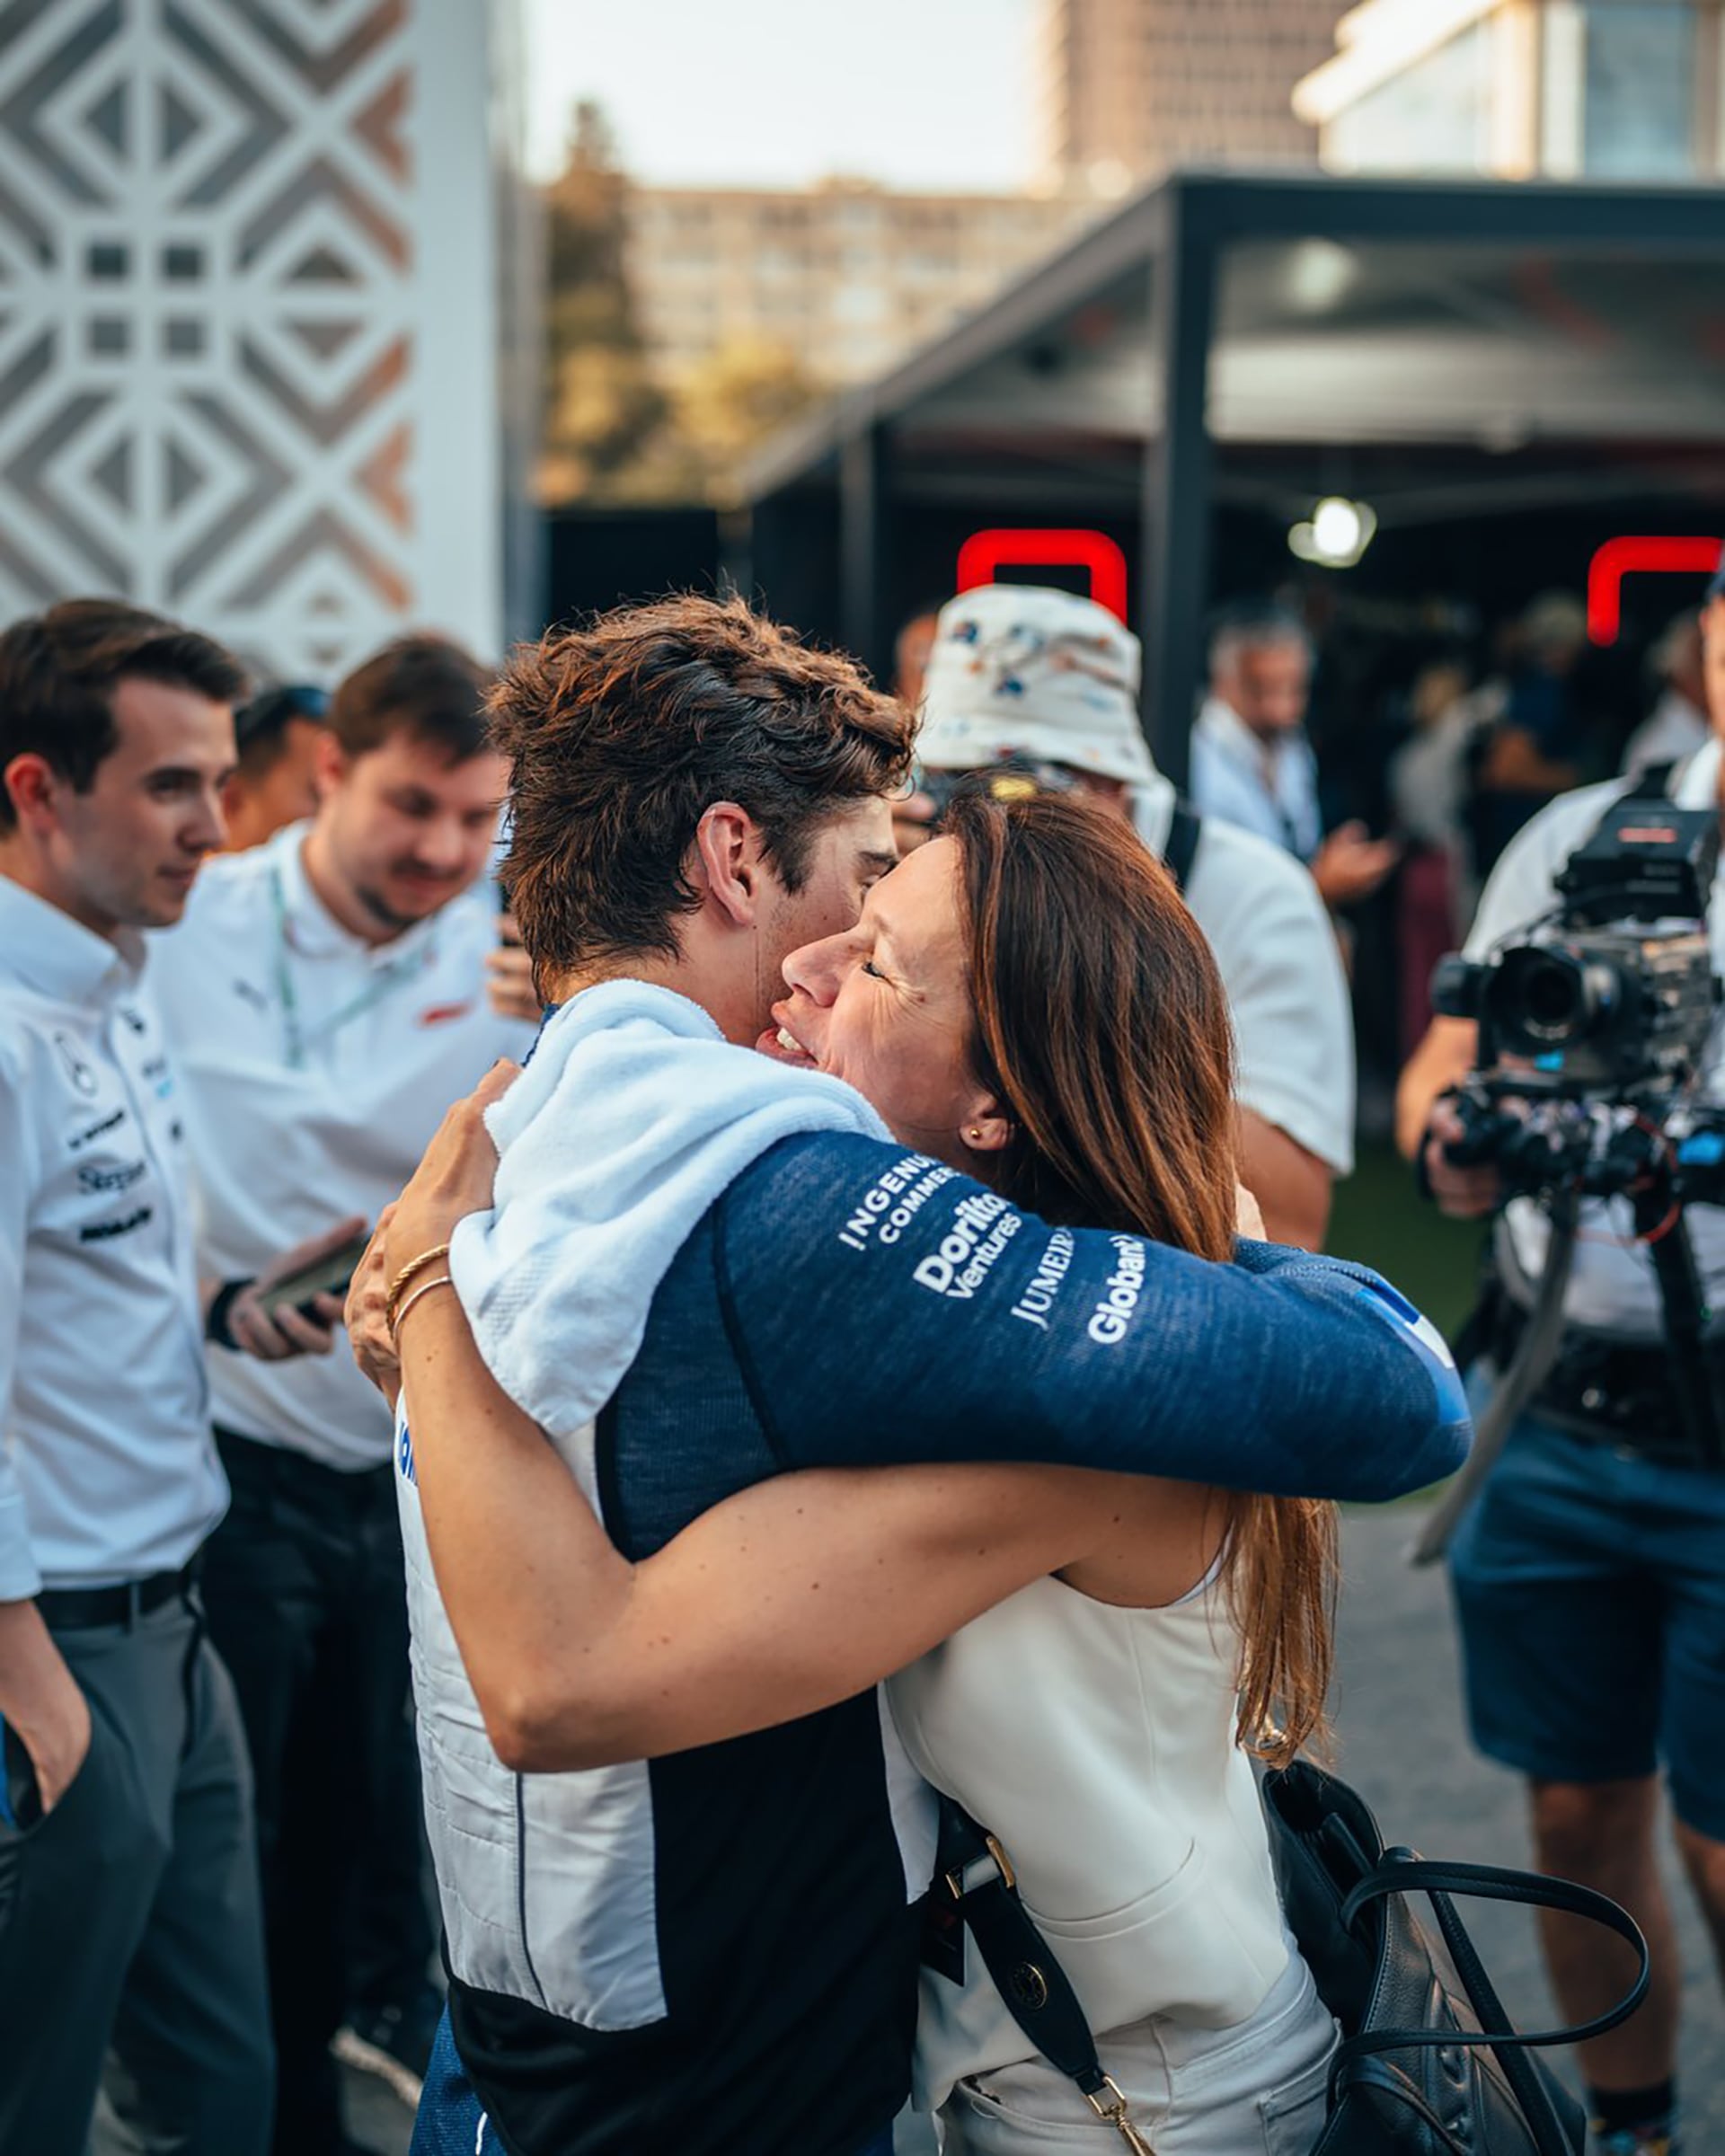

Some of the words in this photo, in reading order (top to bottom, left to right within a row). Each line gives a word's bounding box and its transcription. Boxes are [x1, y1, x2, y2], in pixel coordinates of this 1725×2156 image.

[880, 1167, 961, 1244] COMMER
[914, 1192, 1011, 1294] Dorito
[947, 1213, 1022, 1300] Ventures
